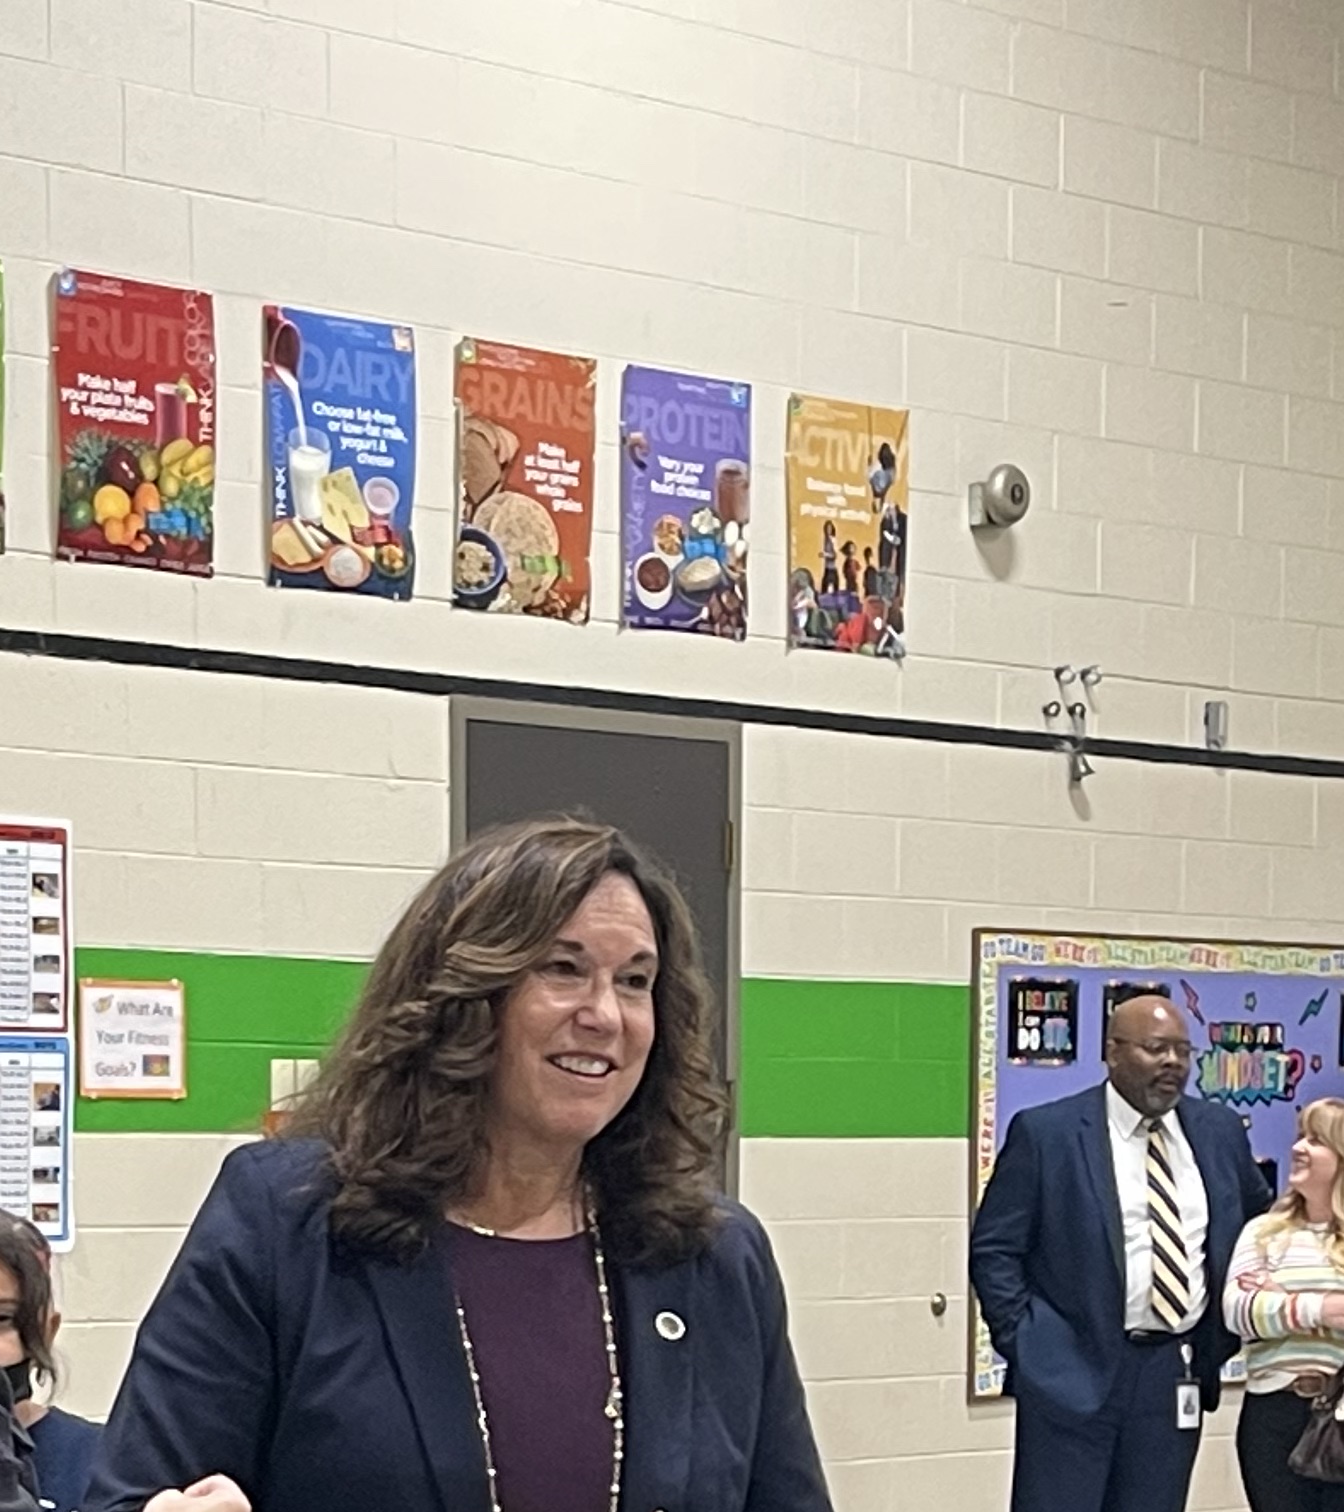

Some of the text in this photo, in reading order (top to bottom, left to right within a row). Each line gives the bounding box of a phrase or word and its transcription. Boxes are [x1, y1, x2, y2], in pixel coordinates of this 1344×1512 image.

[81, 405, 149, 425] vegetables
[197, 387, 213, 442] THINK
[460, 366, 593, 433] GRAINS
[624, 393, 749, 455] PROTEIN
[275, 466, 287, 518] THINK
[116, 1001, 175, 1017] What Are
[96, 1030, 125, 1045] Your
[1017, 1027, 1041, 1051] DO
[95, 1061, 137, 1077] Goals?
[1201, 1049, 1305, 1098] MINDSET?
